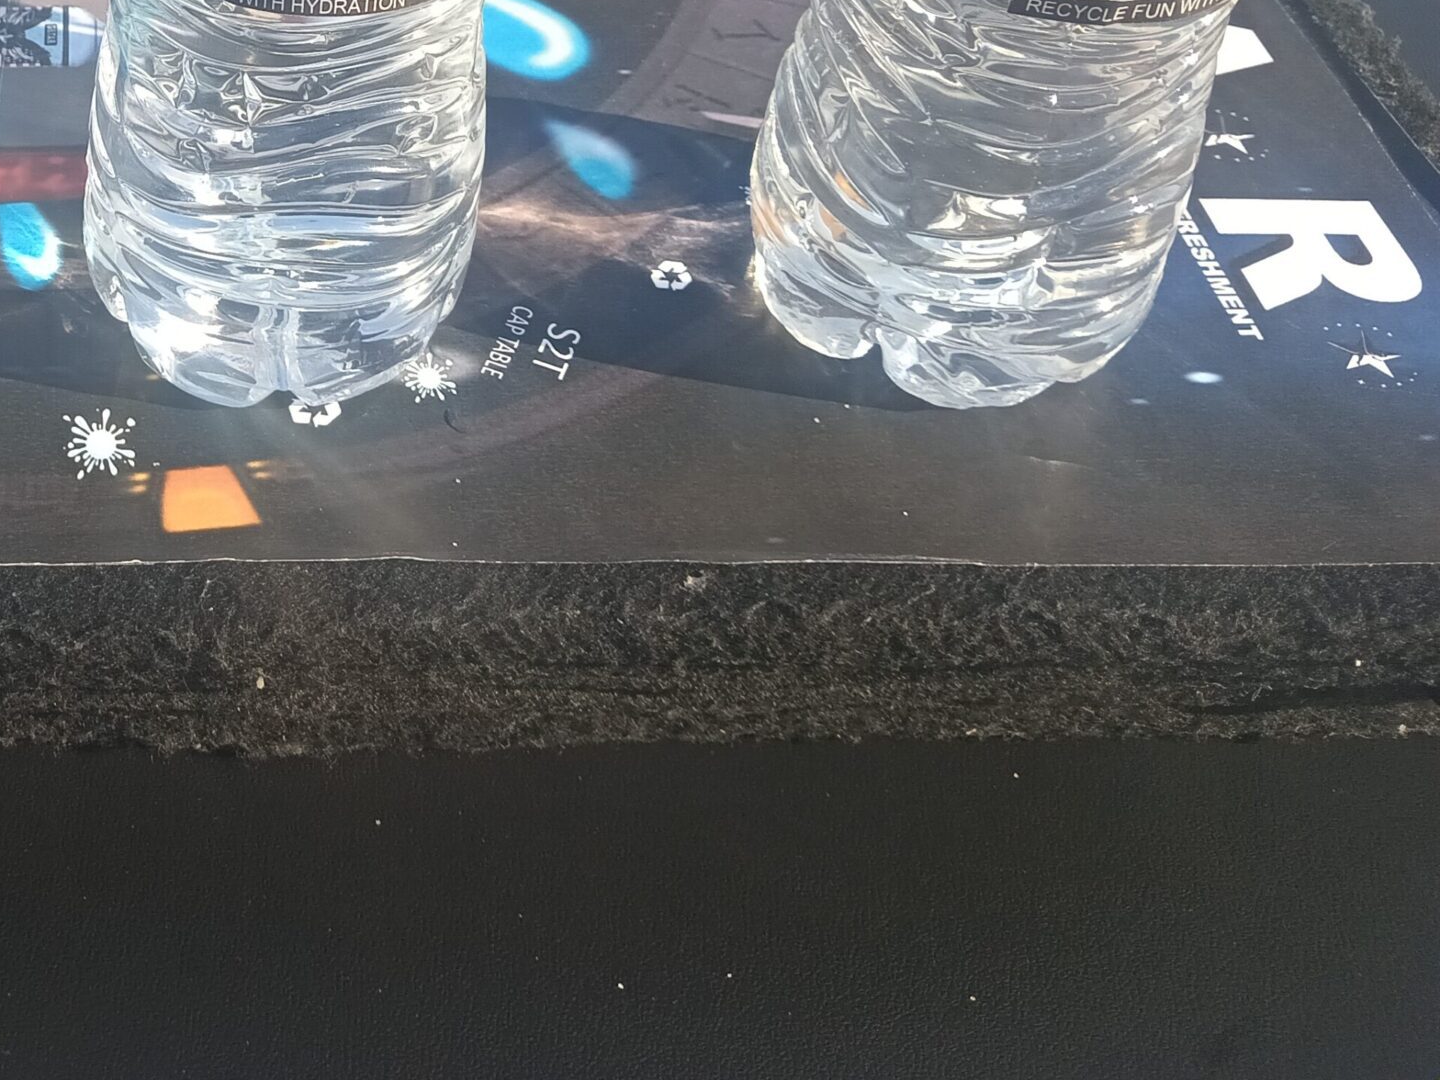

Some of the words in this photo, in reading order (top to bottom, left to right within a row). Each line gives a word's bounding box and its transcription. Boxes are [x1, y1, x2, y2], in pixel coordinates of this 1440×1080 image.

[1131, 1, 1176, 19] FUN
[505, 306, 533, 335] CAP
[480, 336, 520, 380] TABLE
[532, 323, 581, 380] S2T
